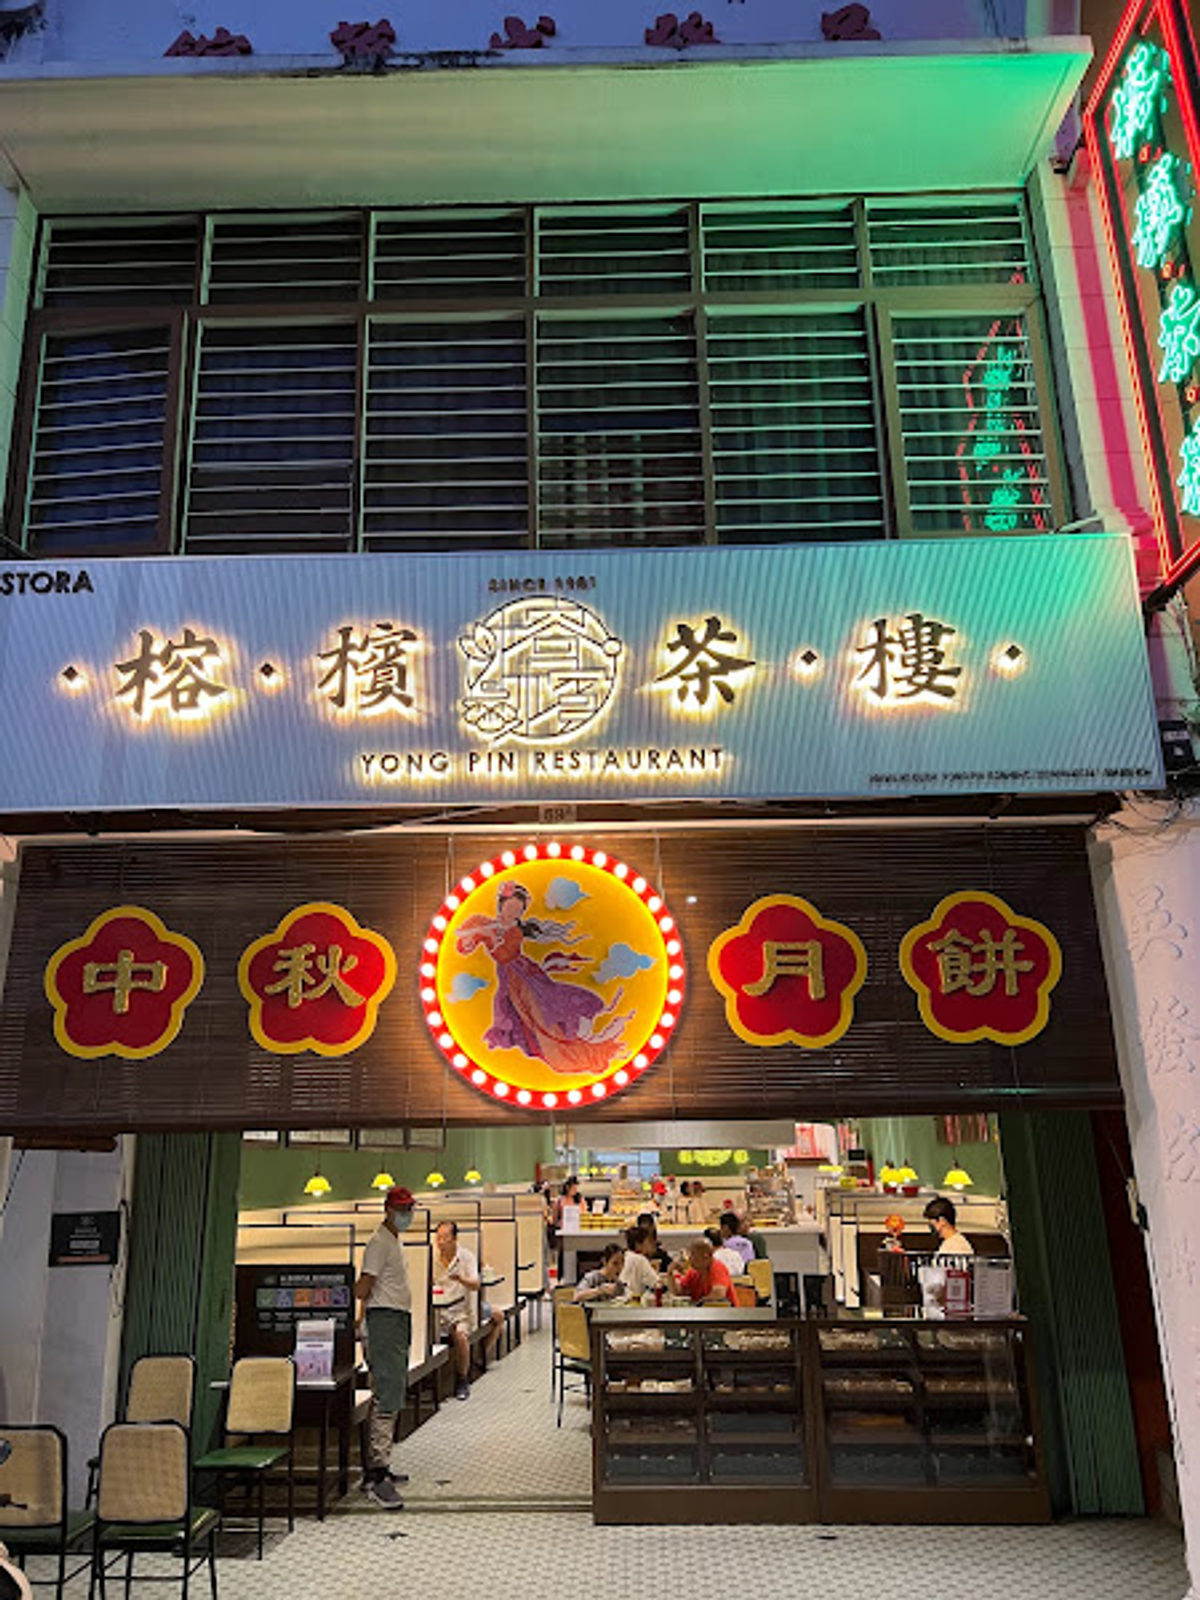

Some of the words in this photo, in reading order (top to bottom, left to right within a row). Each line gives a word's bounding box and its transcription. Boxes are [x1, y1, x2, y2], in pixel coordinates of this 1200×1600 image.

[0, 570, 95, 595] STORA
[114, 627, 229, 714] 榕
[316, 622, 417, 708] 檳
[655, 616, 756, 704] 茶
[857, 613, 963, 699] 樓
[361, 751, 449, 774] YONG
[468, 751, 514, 773] PIN
[534, 748, 722, 772] RESTAURANT
[82, 950, 168, 1014] 中
[264, 943, 367, 1008] 秋
[742, 940, 827, 1000] 月
[926, 928, 1034, 997] 餅
